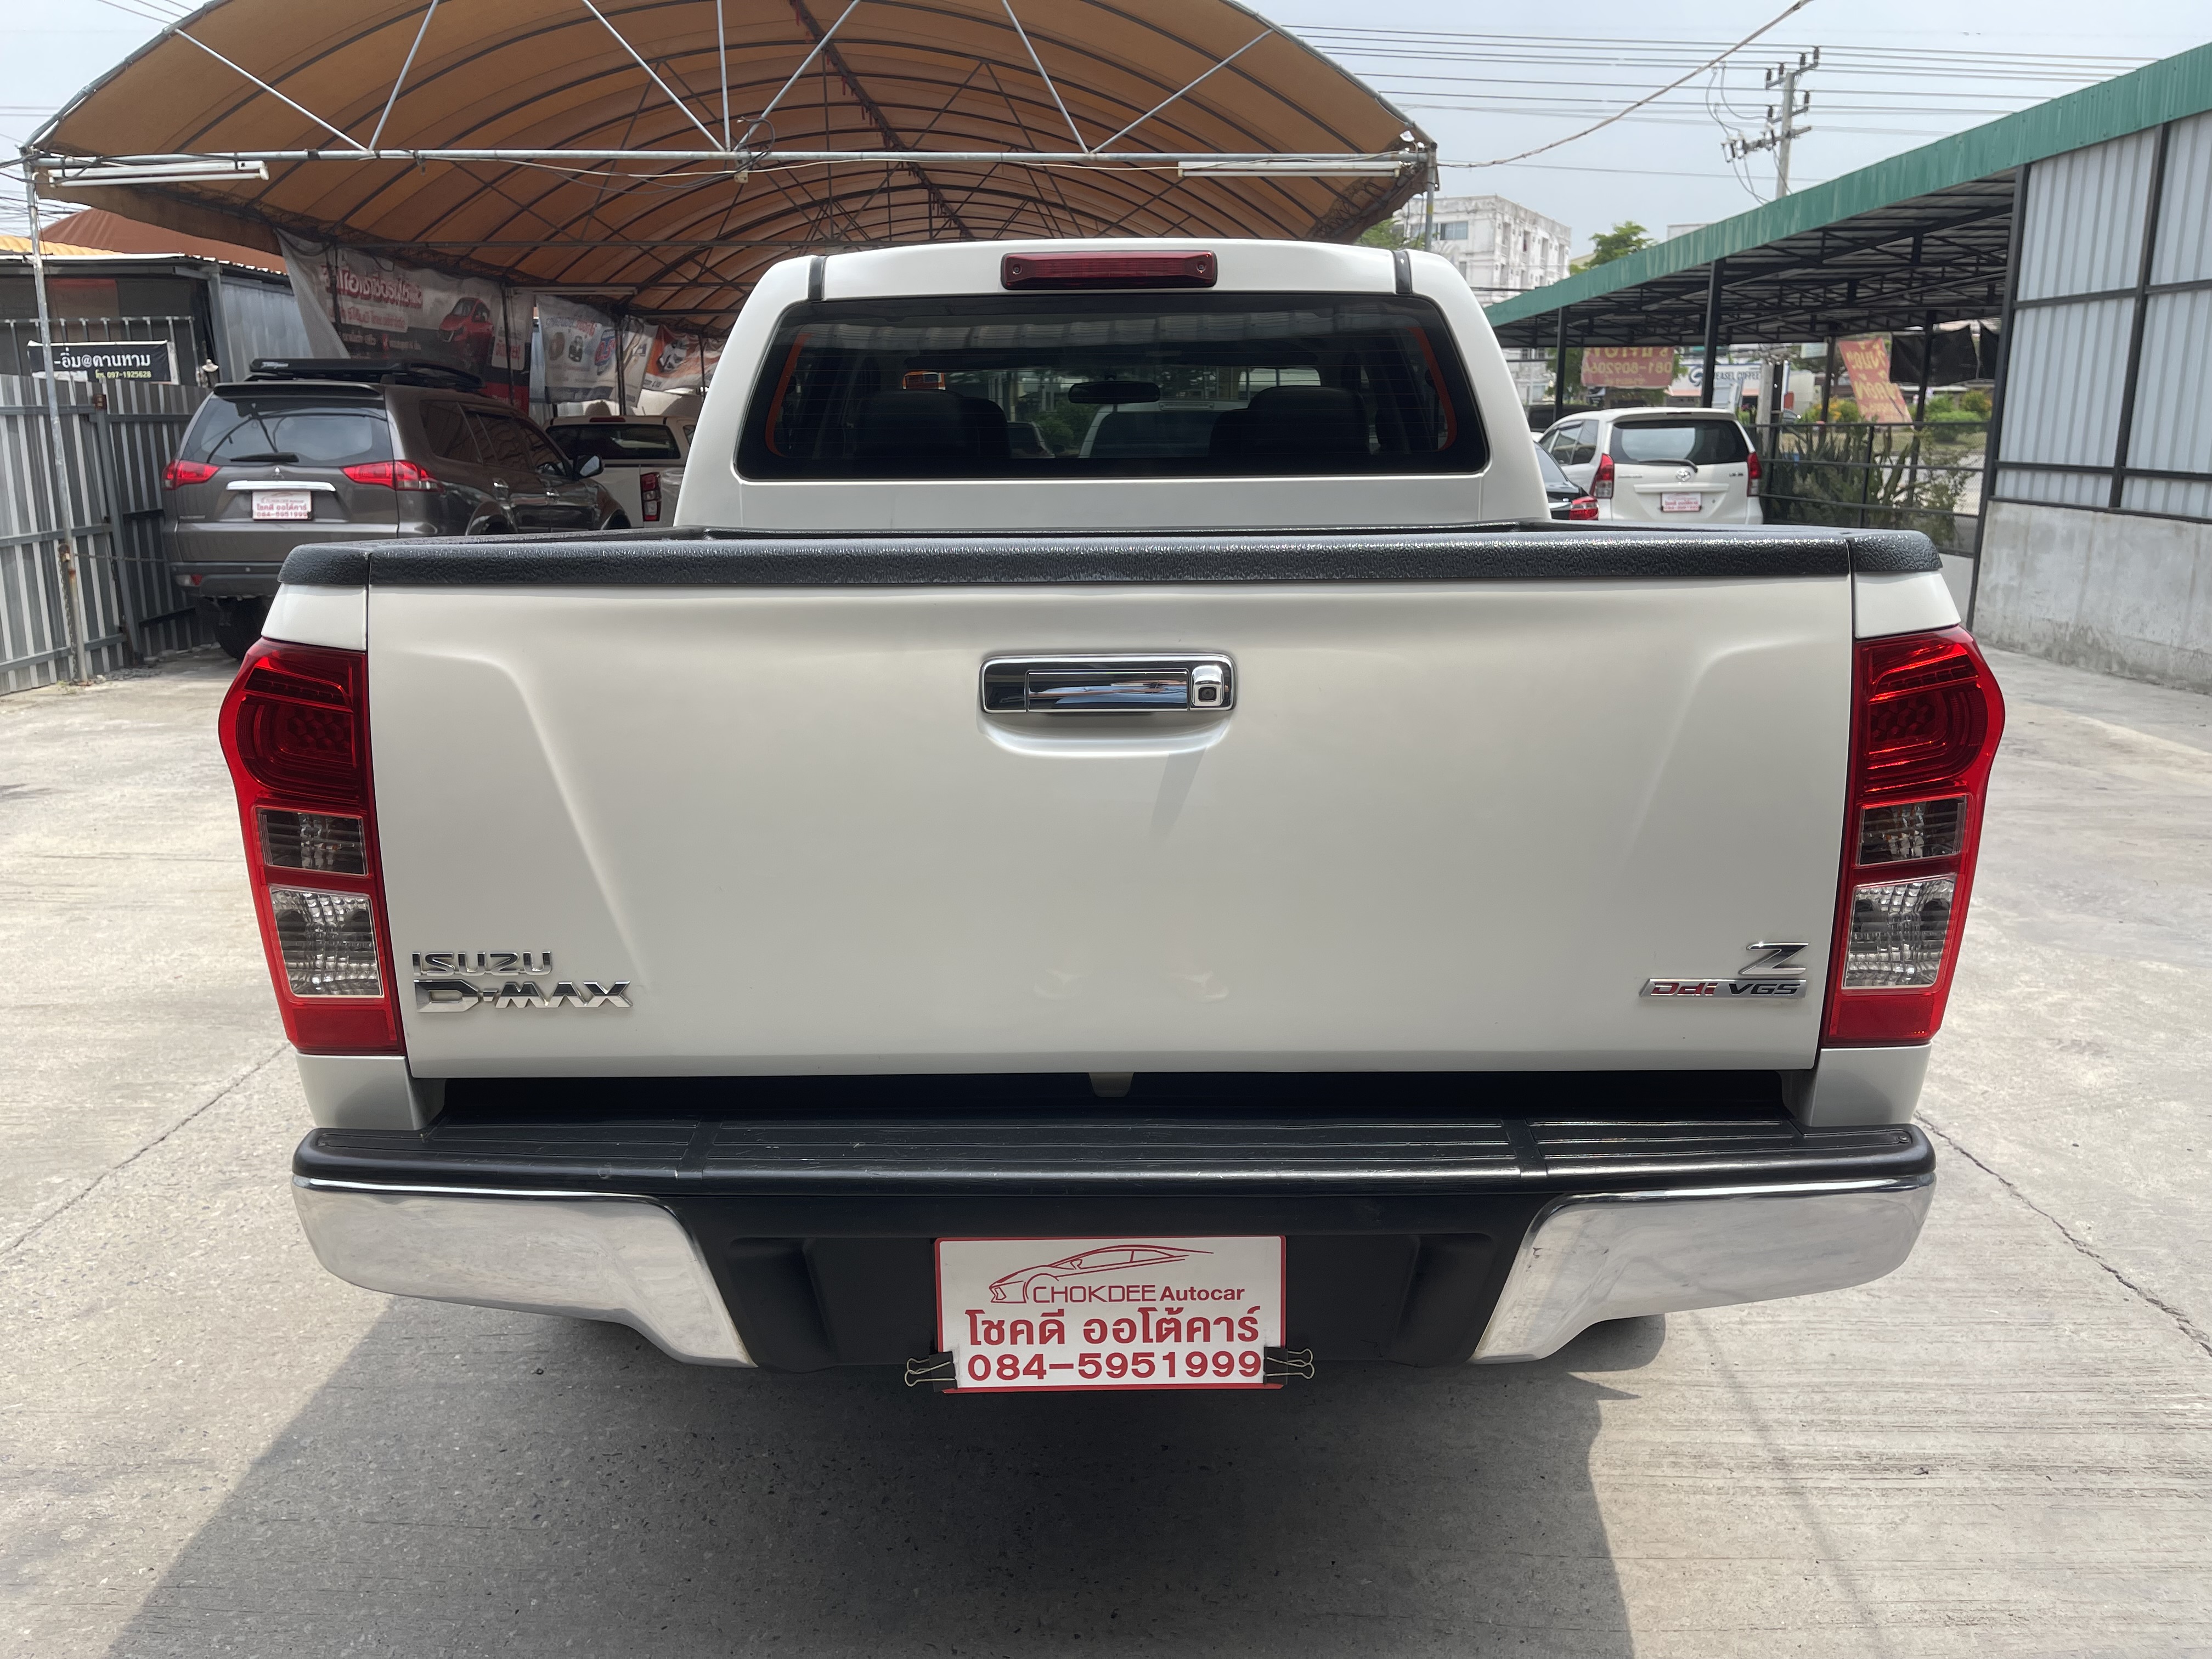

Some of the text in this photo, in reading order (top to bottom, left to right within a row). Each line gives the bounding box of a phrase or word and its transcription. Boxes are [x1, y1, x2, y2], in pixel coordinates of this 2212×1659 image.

[412, 951, 552, 977] ISUZU
[1739, 942, 1809, 975] Z
[414, 979, 634, 1013] D-MAX
[1729, 983, 1801, 995] VGS
[1032, 1284, 1245, 1304] CHOKDEE Autocar
[966, 1305, 1261, 1347] โชคดี ออโต้คาร์
[967, 1350, 1262, 1381] 084-5951999
